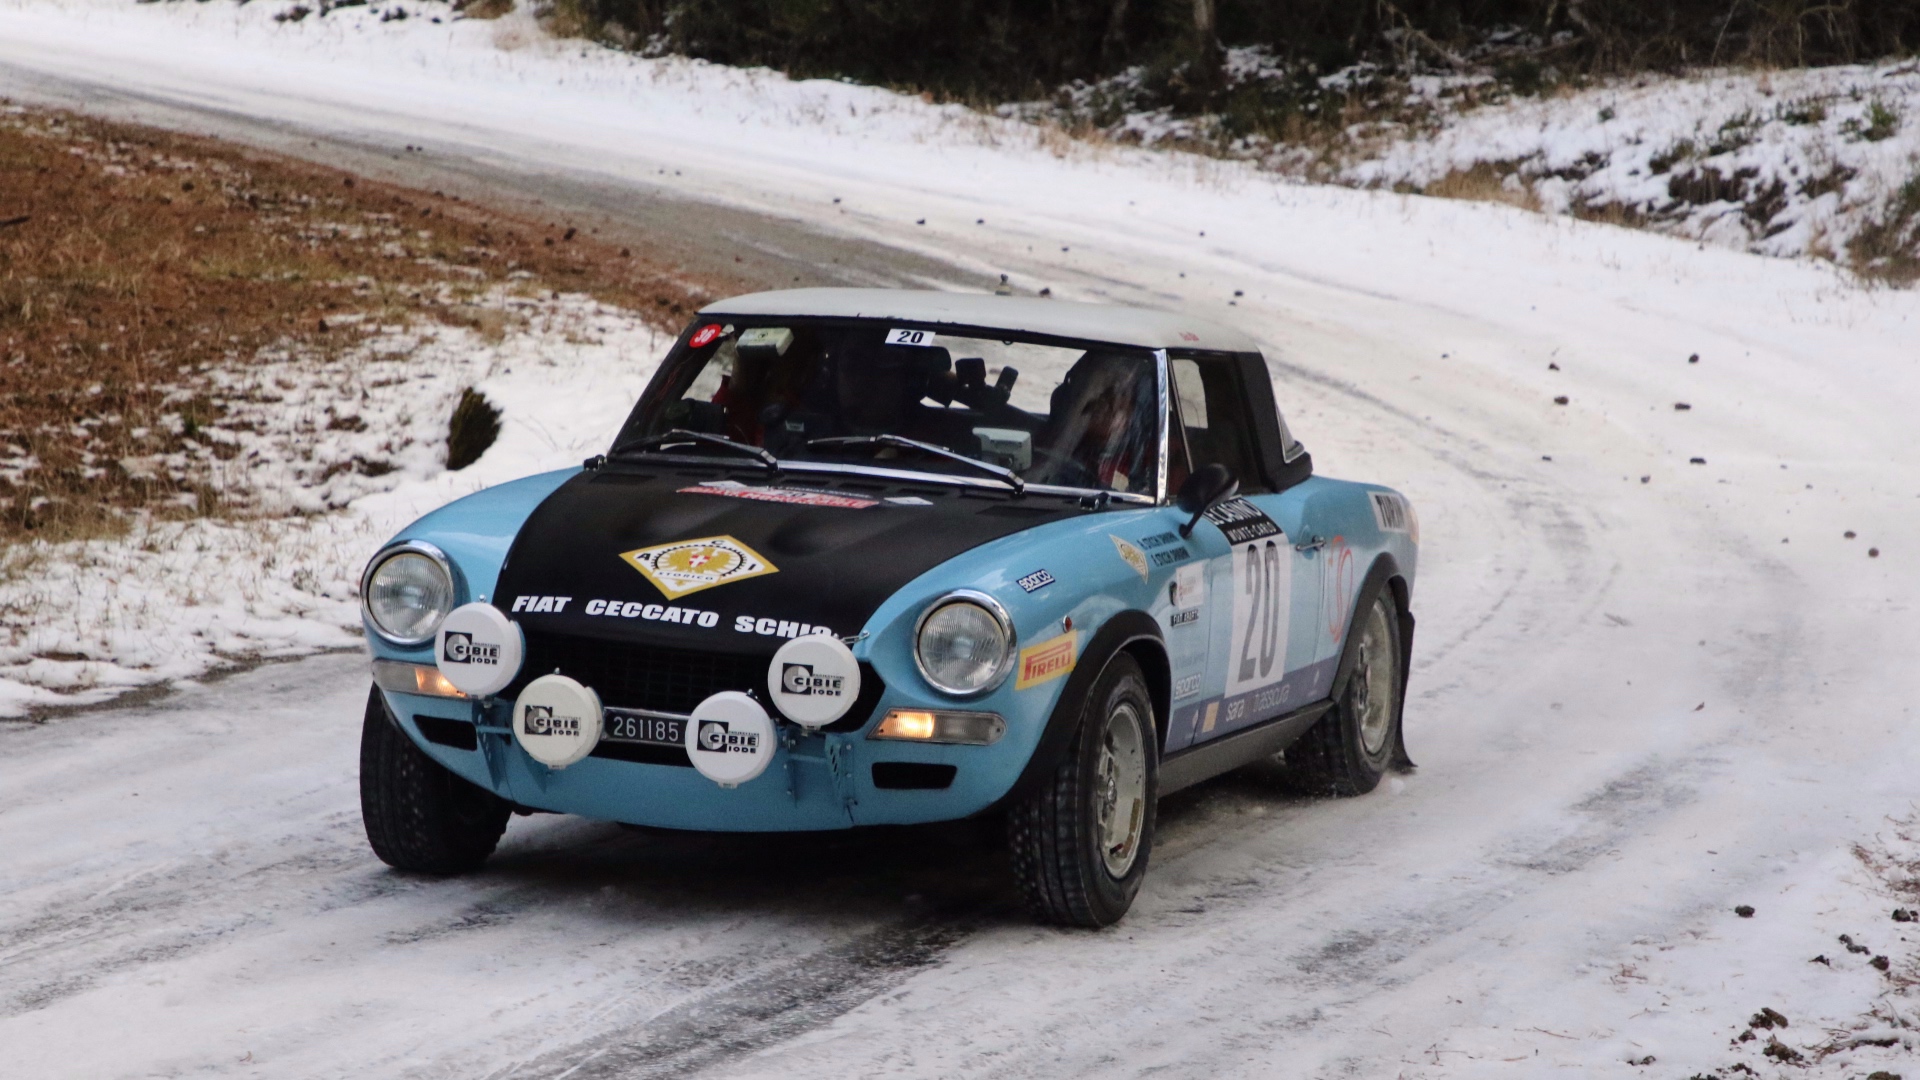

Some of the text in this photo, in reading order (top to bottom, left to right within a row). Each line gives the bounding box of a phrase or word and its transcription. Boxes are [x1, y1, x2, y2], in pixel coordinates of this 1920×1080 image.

[896, 330, 925, 344] 20
[1216, 500, 1263, 523] CASINO
[636, 552, 651, 561] A
[747, 563, 757, 571] I
[657, 571, 714, 581] STORICO
[1018, 570, 1051, 590] sparco
[511, 595, 573, 613] FIAT
[585, 598, 720, 628] CECCATO
[1237, 540, 1280, 683] 20
[454, 645, 499, 657] CIBIE
[472, 657, 498, 665] IODE
[1023, 640, 1073, 681] PIRELLI
[794, 677, 842, 689] CIBIE
[1175, 673, 1201, 696] sparco
[813, 688, 842, 696] IODE
[1225, 699, 1245, 722] sara
[535, 718, 579, 729] CIBIE
[612, 716, 680, 742] 261185
[553, 729, 580, 737] IODE
[709, 734, 757, 746] CIBIE
[728, 746, 757, 754] IODE
